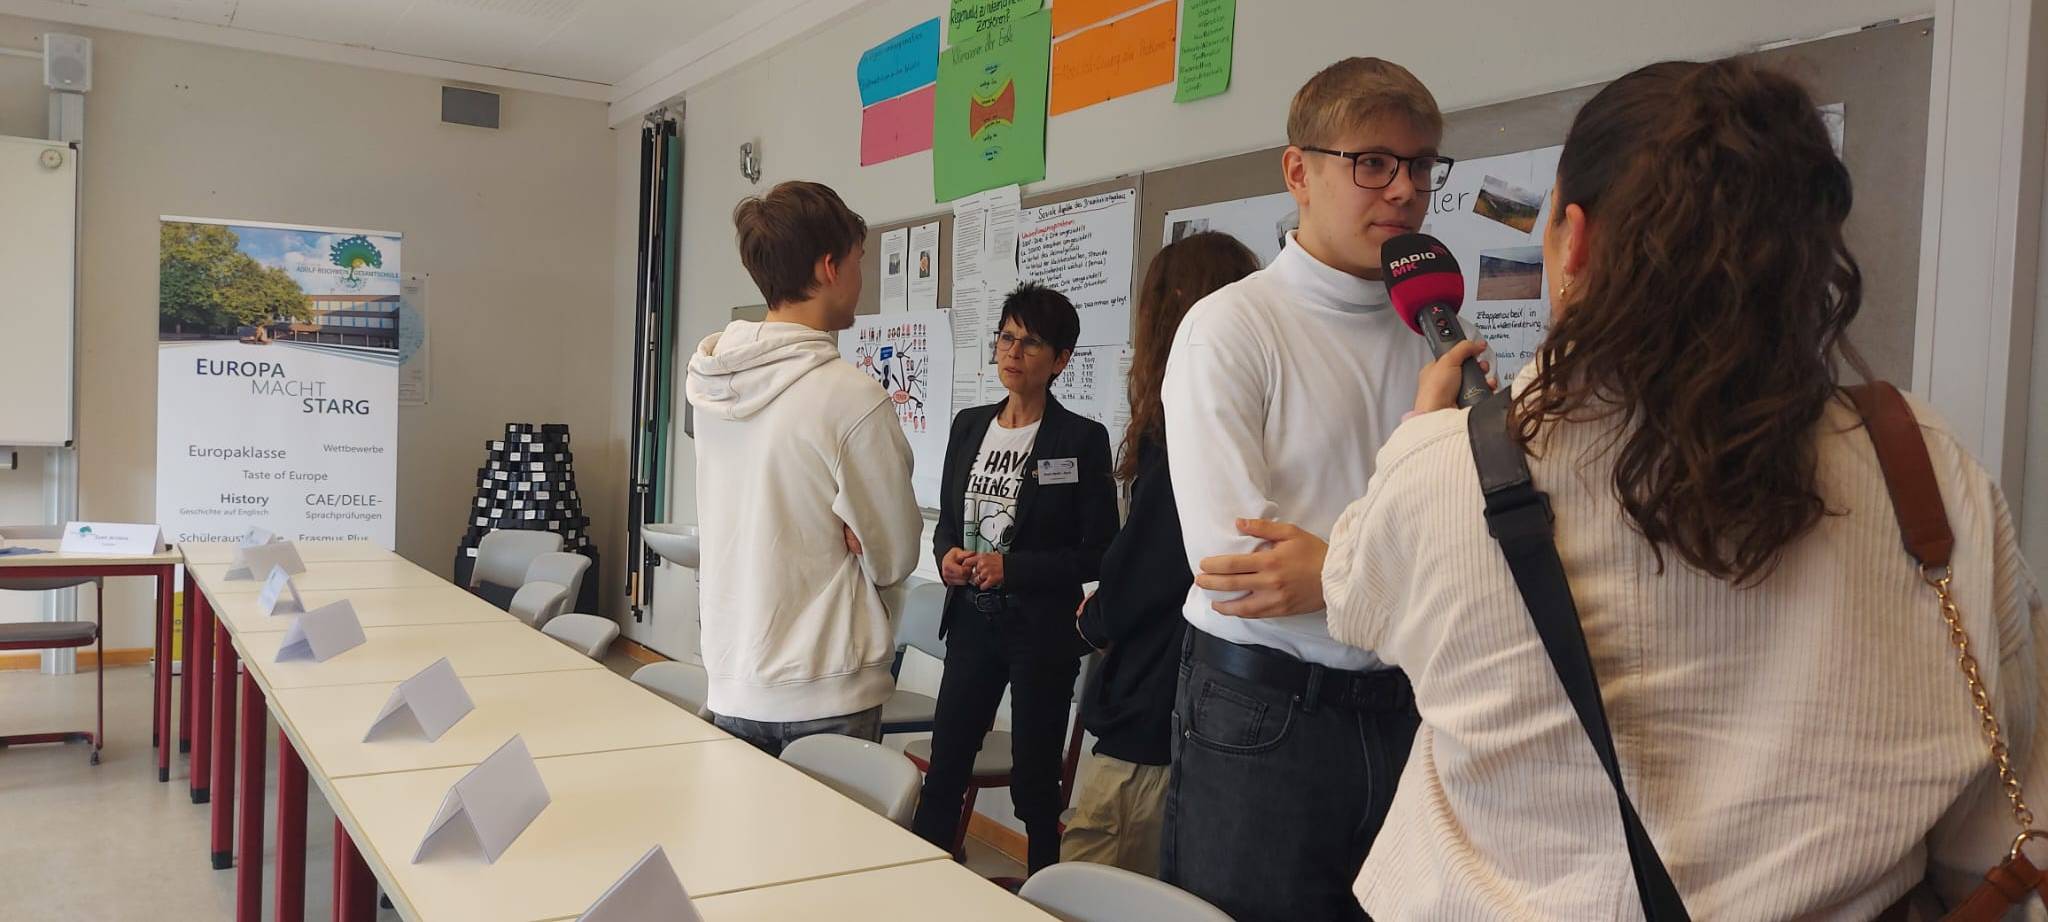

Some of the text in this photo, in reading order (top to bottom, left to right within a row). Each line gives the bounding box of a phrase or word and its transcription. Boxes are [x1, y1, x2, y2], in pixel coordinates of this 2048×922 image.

[1390, 252, 1436, 270] RADIO
[1392, 262, 1418, 278] MK
[196, 357, 286, 378] EUROPA
[251, 379, 327, 397] MACHT
[302, 397, 370, 416] STARG
[188, 444, 287, 460] Europaklasse
[323, 443, 384, 454] Wettbewerbe
[984, 450, 1028, 475] HAV
[243, 470, 328, 482] Taste of Europe
[220, 493, 270, 507] History
[305, 493, 383, 507] CAE/DELE-
[179, 507, 270, 517] Geschichte auf Englisch
[305, 511, 382, 521] Sprachprüfungen
